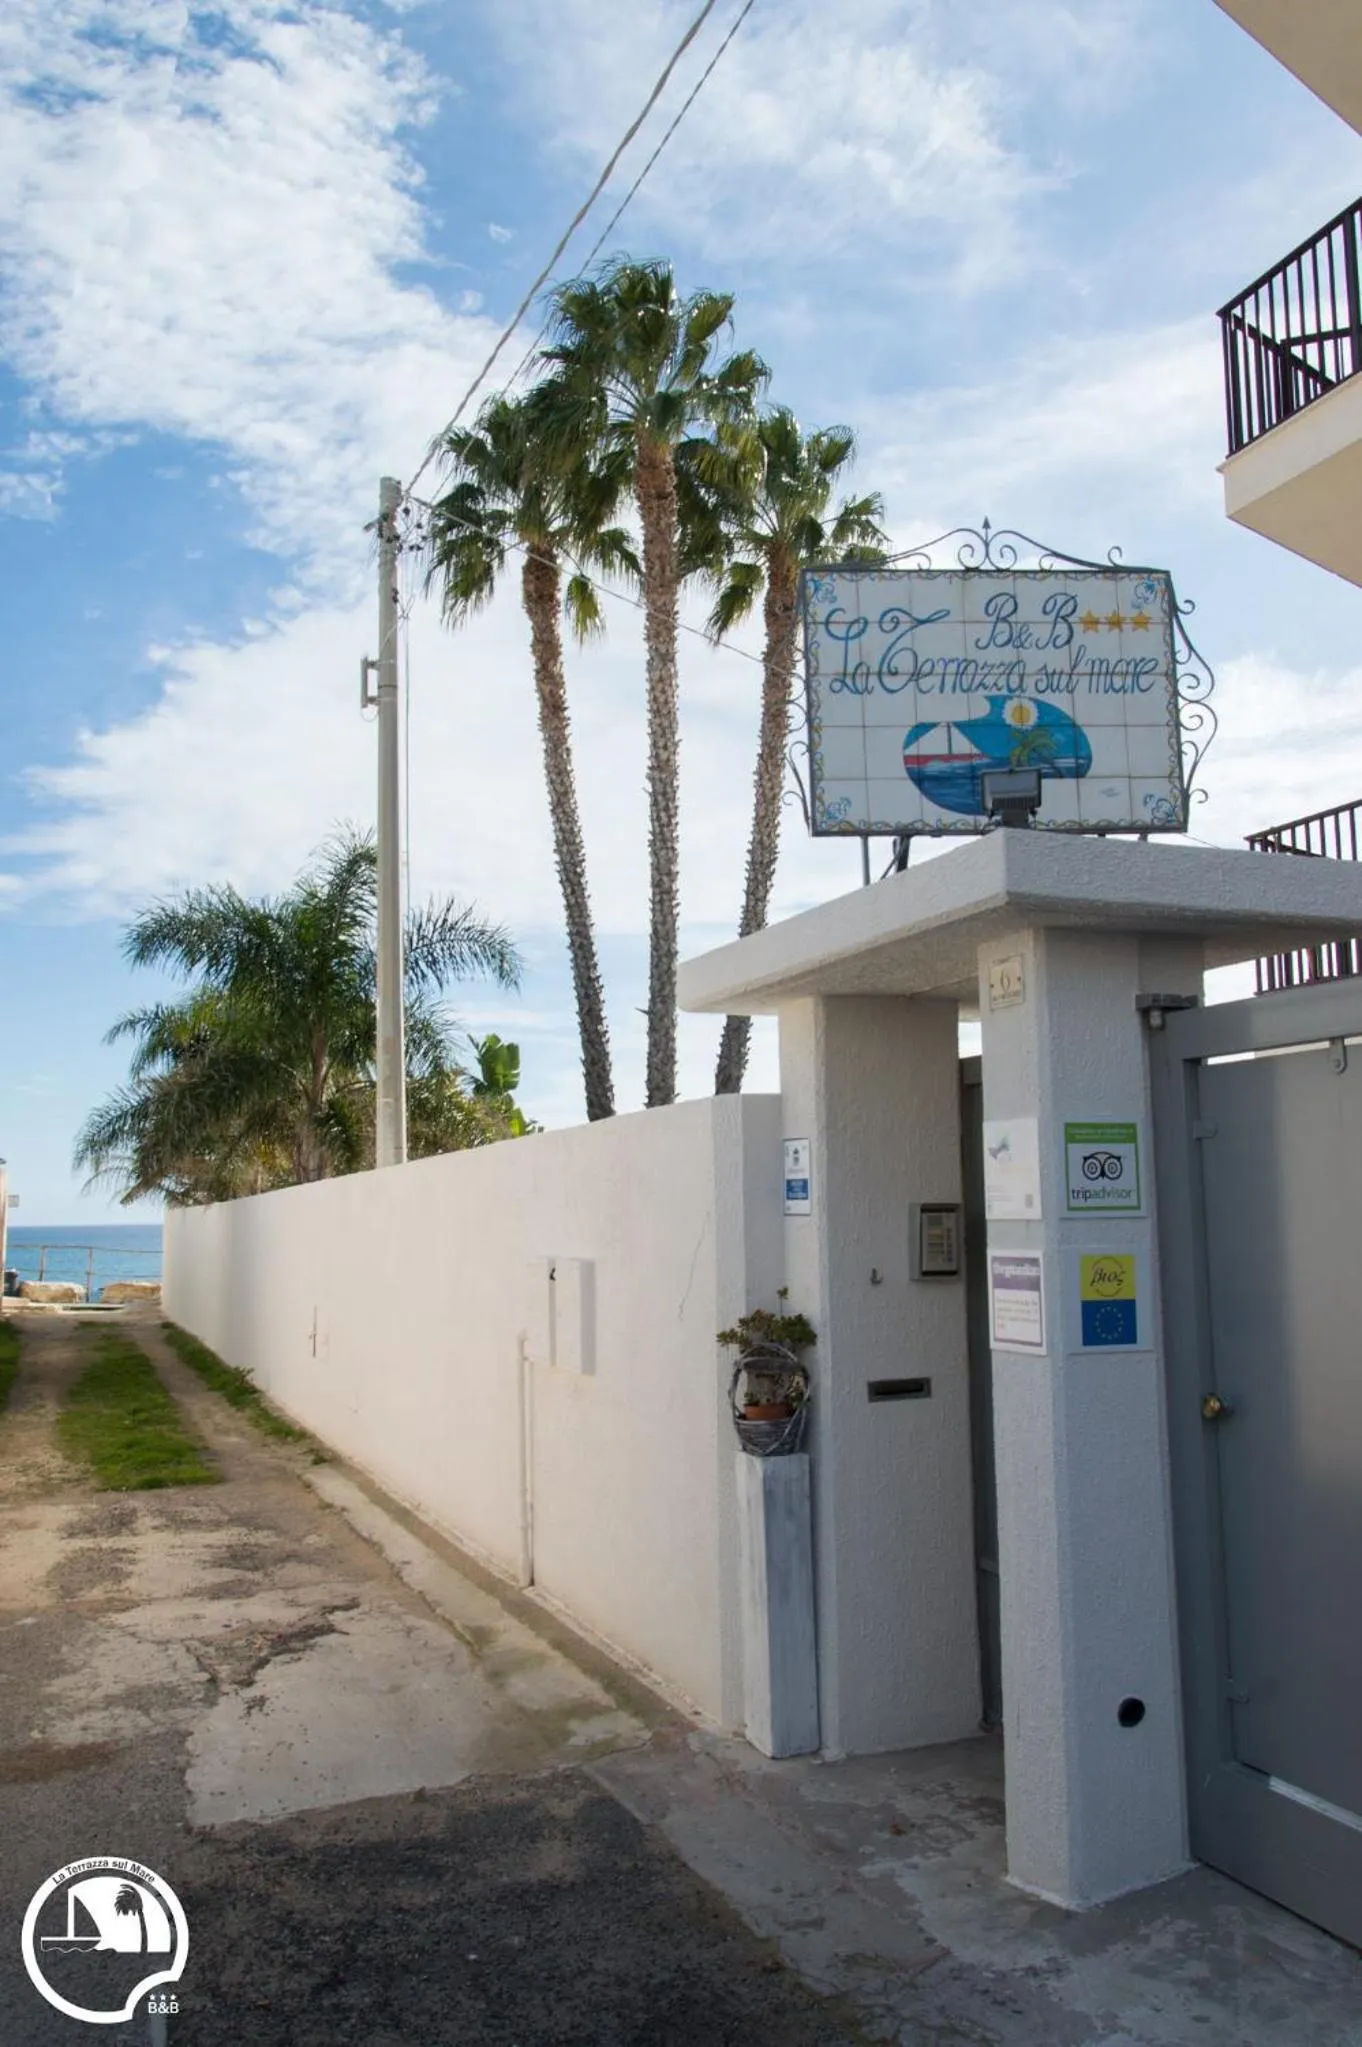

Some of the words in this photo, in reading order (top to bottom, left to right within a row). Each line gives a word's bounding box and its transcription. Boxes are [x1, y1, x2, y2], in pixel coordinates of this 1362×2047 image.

[975, 592, 1078, 650] B&B
[825, 607, 876, 695] La
[877, 607, 1027, 695] Terrazza
[1034, 644, 1087, 694] sul
[1085, 655, 1159, 694] mare
[1071, 1187, 1133, 1202] tripadvisor
